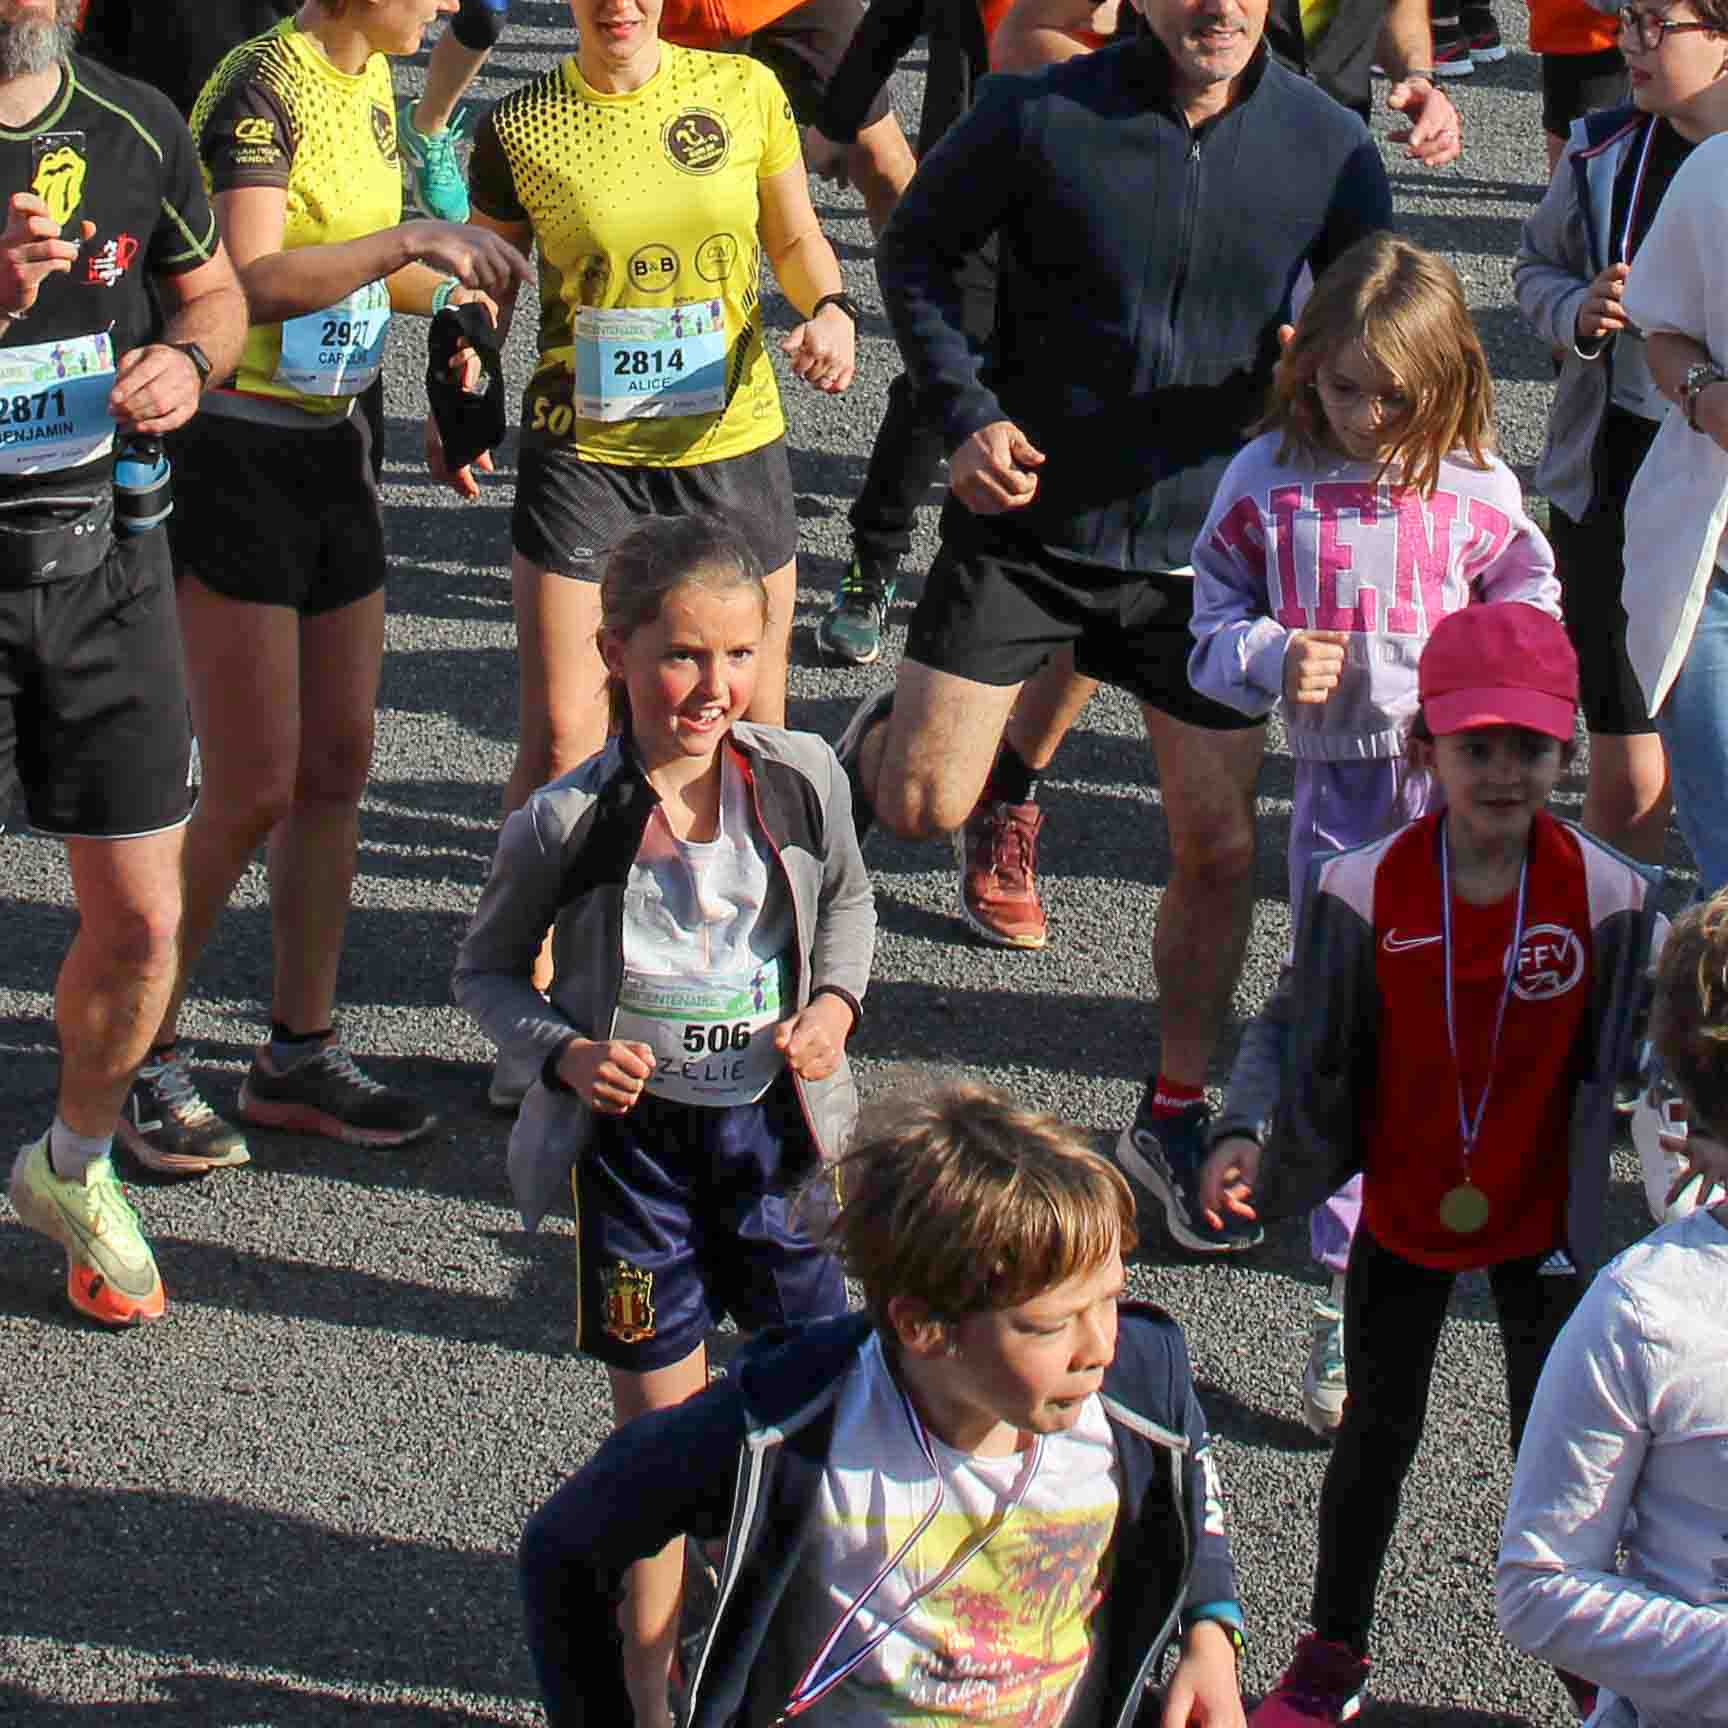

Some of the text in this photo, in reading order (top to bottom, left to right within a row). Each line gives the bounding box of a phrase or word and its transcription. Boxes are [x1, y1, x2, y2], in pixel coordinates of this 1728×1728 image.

[322, 320, 369, 347] 2927
[613, 348, 684, 377] 2814
[628, 377, 672, 392] ALICE
[683, 1021, 750, 1055] 506
